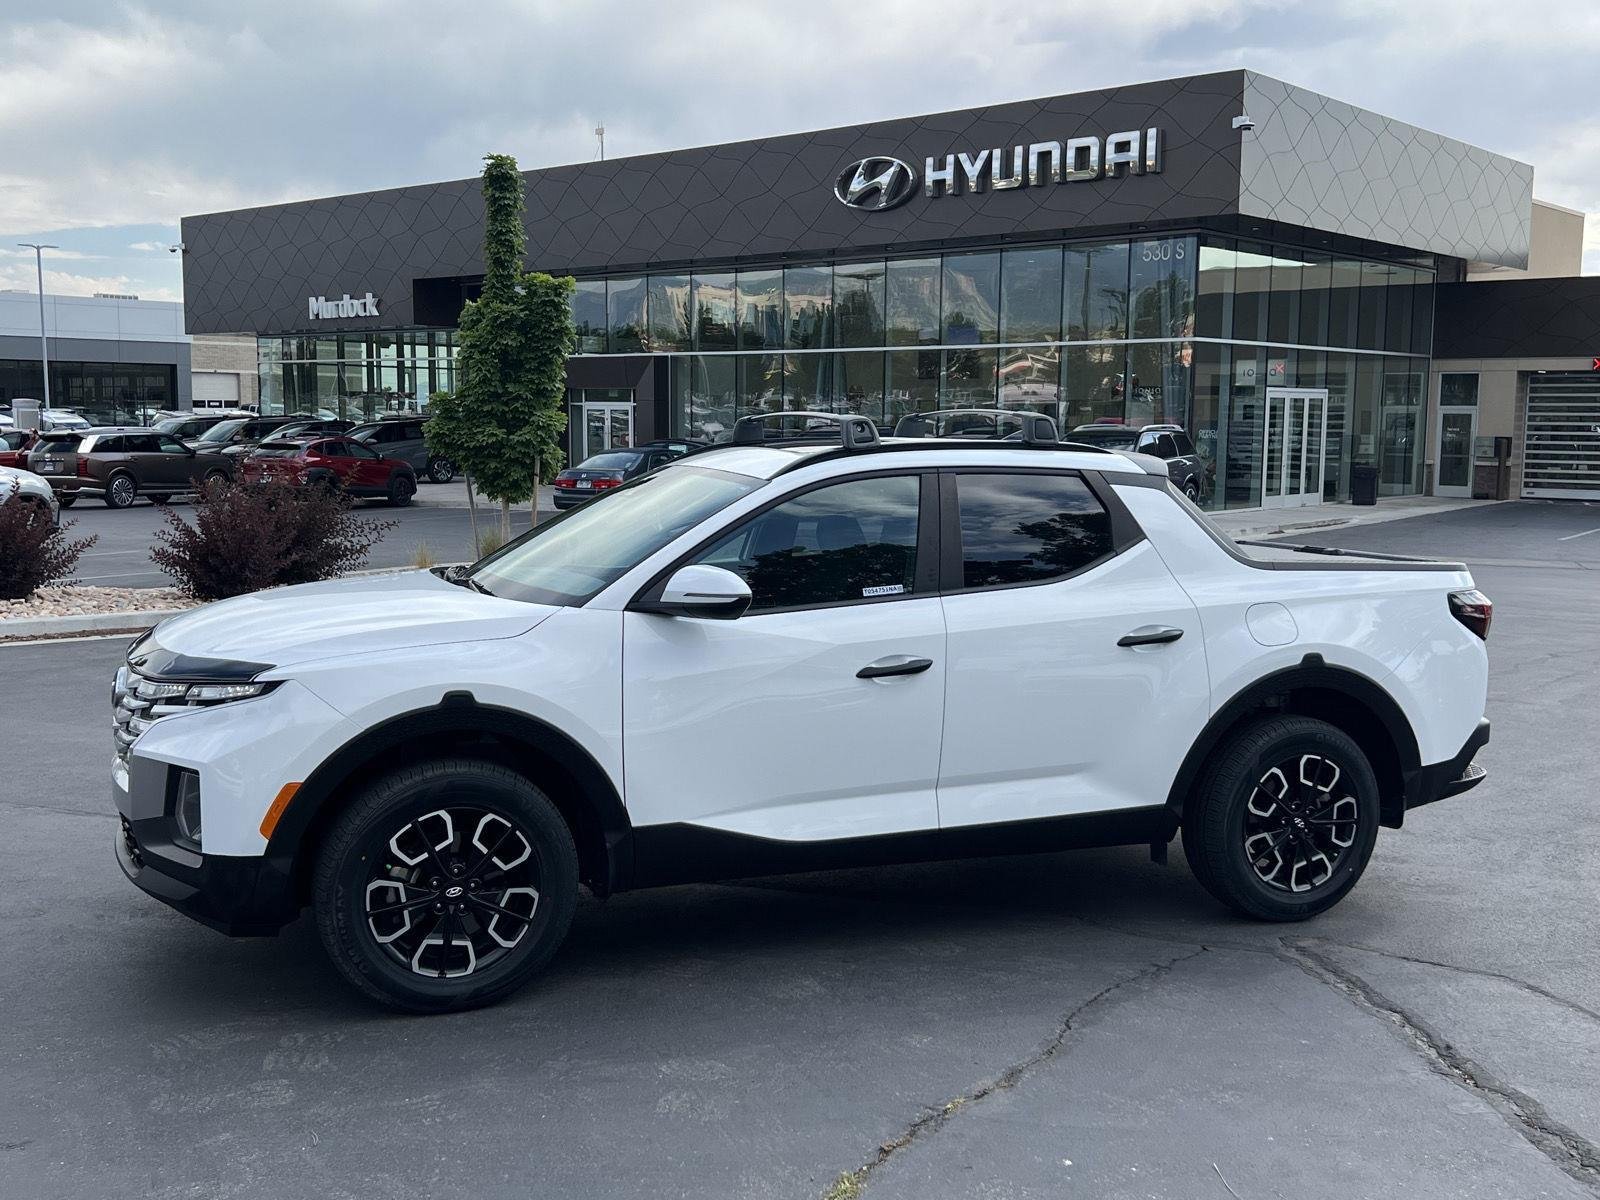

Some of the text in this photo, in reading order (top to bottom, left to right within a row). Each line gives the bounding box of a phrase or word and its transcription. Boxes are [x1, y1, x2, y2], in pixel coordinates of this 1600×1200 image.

[925, 127, 1162, 197] HYUNDAI
[1142, 242, 1185, 262] 530 S
[308, 292, 380, 320] Murdock
